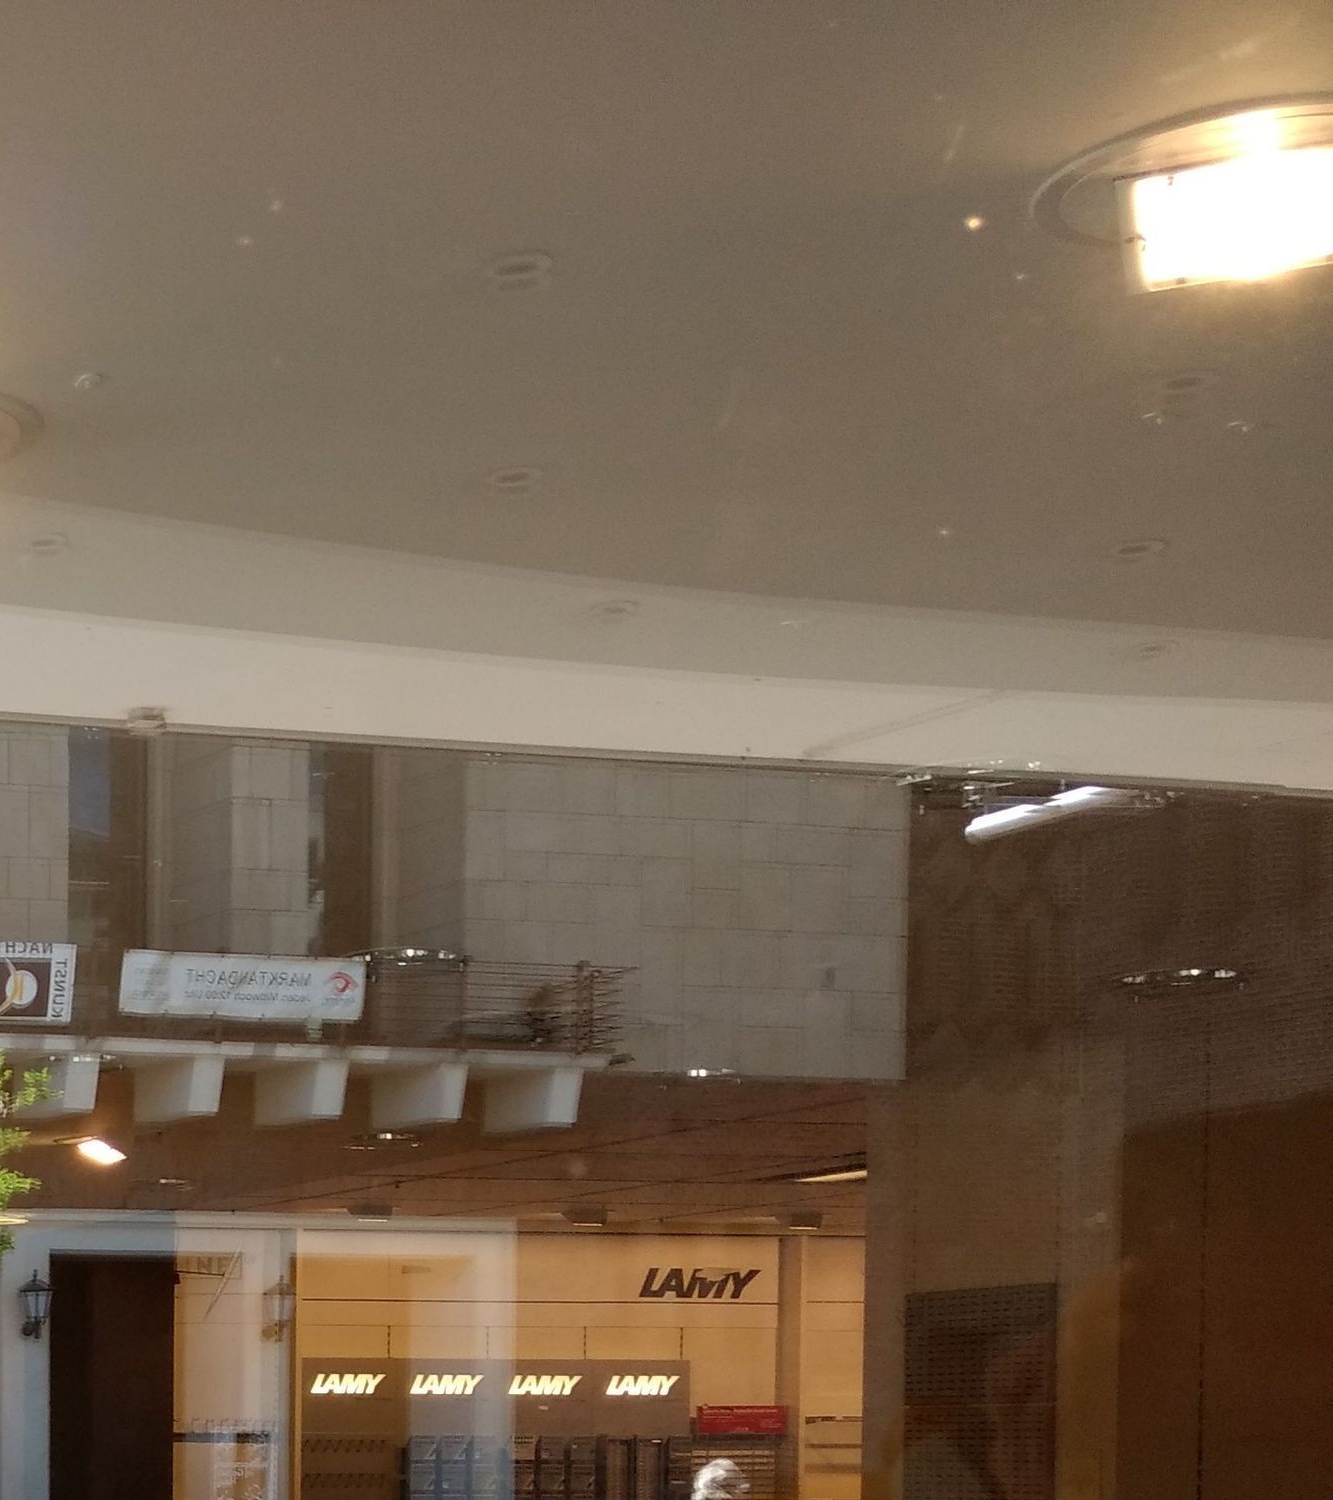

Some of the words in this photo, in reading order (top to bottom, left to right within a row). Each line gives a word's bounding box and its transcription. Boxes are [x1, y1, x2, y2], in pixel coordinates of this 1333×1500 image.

[639, 1267, 762, 1299] LAMY
[310, 1373, 386, 1395] LAMY
[409, 1374, 484, 1396] LAMY
[508, 1375, 582, 1396] LAMY
[605, 1375, 680, 1396] LAMY
